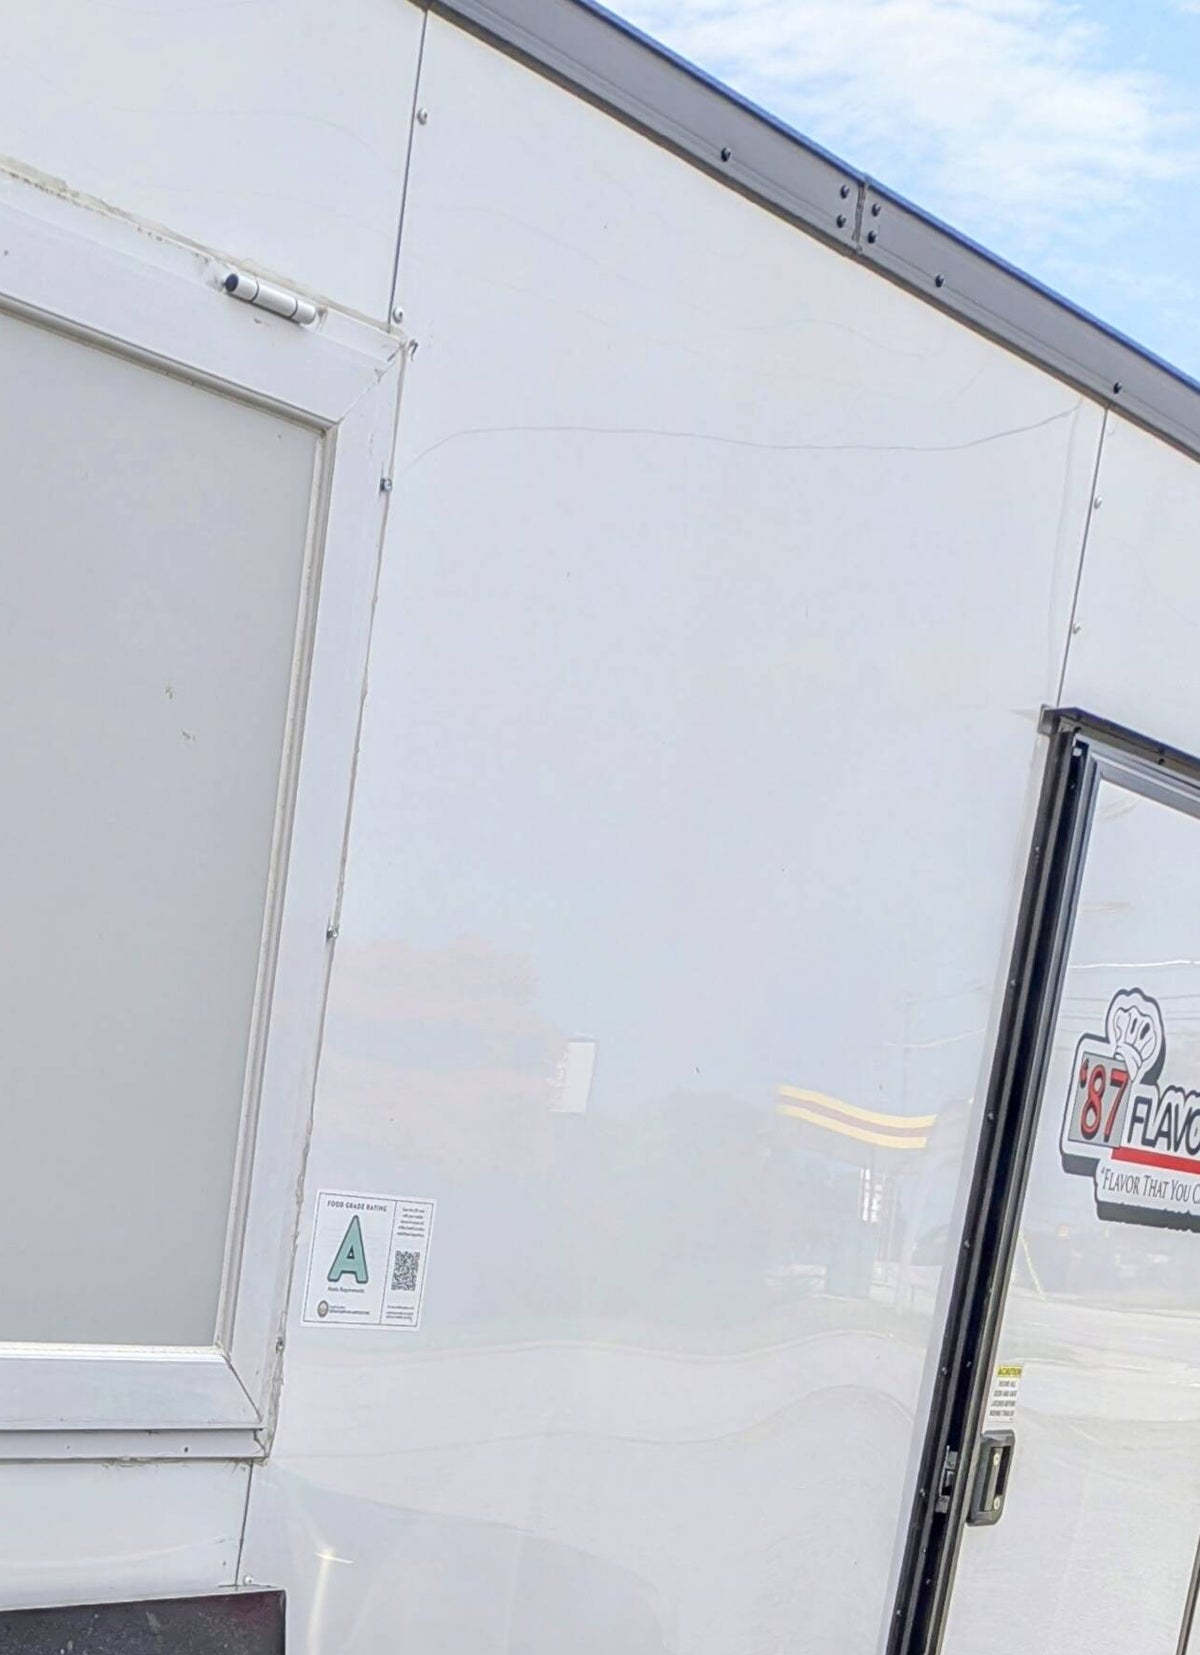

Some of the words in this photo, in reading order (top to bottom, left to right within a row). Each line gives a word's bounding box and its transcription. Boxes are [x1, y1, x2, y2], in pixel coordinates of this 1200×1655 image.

[1079, 1058, 1130, 1143] '87
[327, 1200, 344, 1209] FOOD
[345, 1202, 365, 1210] GRADE
[366, 1204, 388, 1212] RATING
[327, 1215, 369, 1284] A
